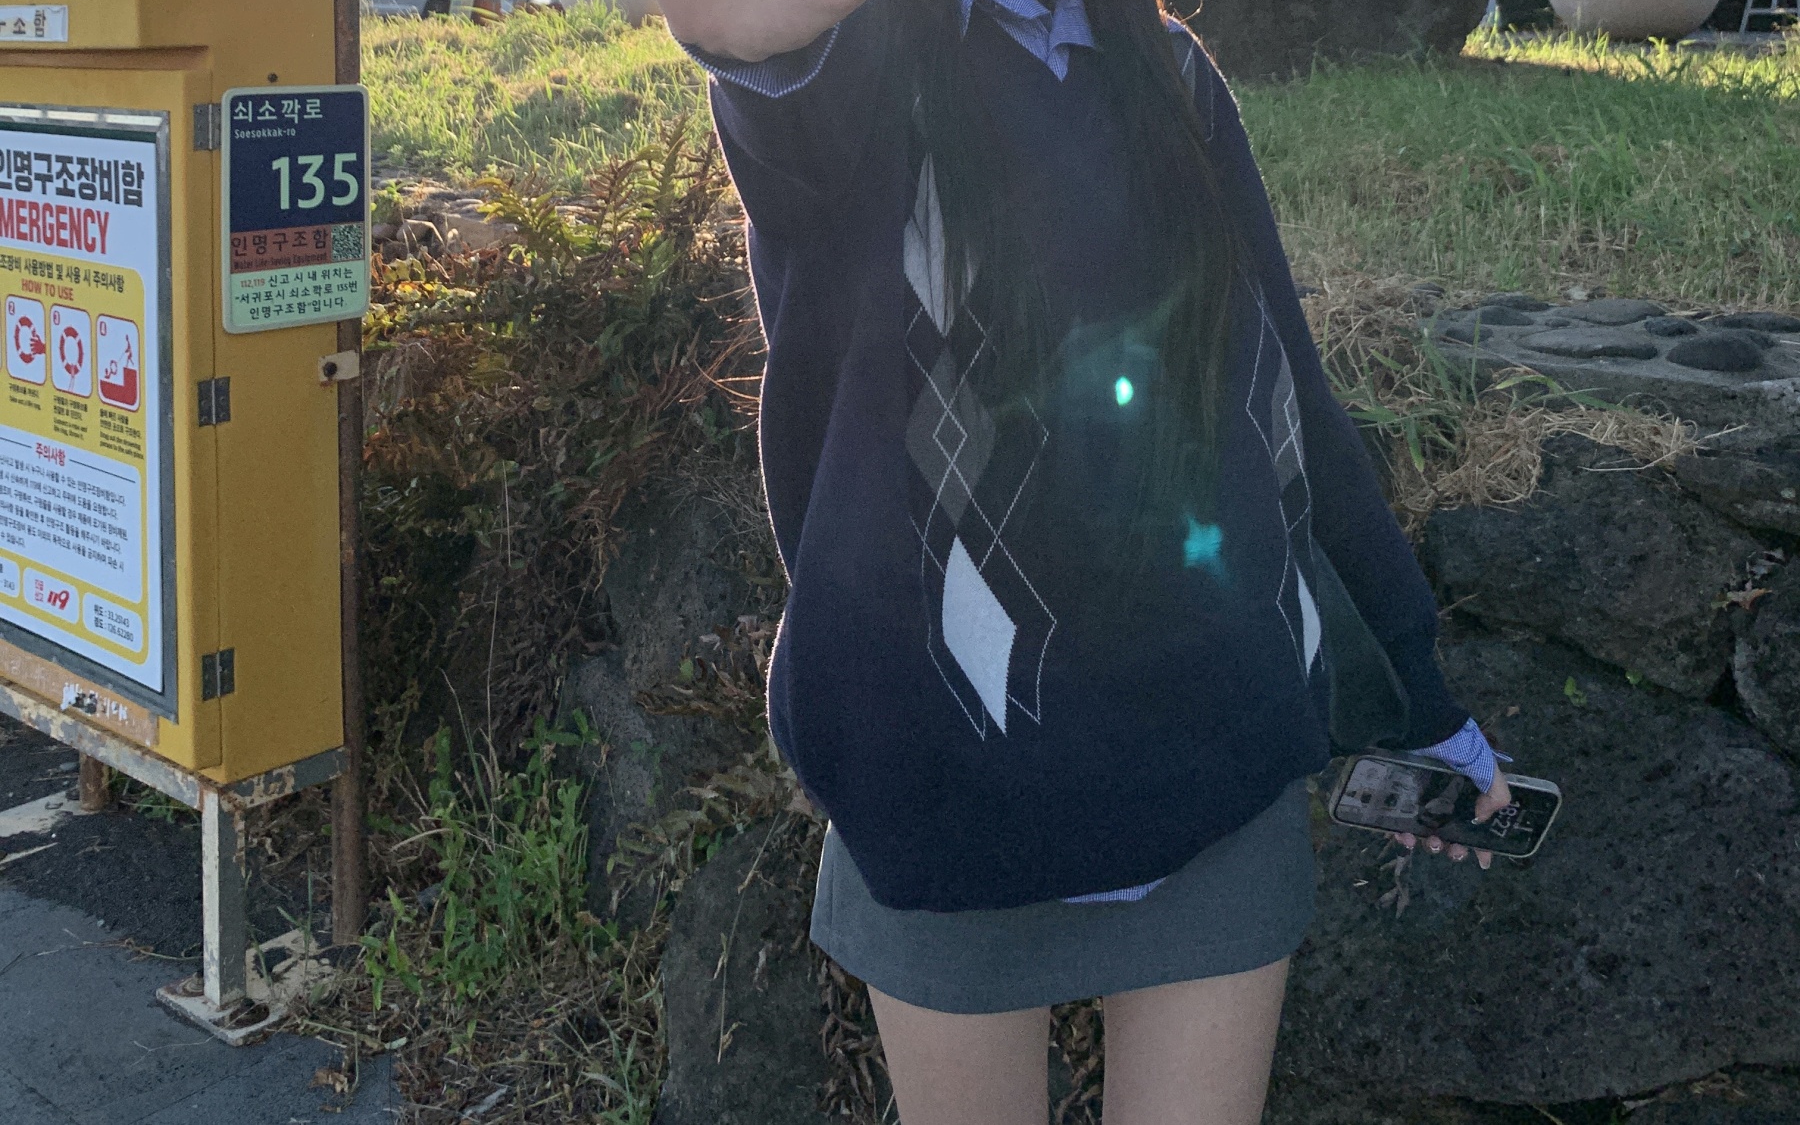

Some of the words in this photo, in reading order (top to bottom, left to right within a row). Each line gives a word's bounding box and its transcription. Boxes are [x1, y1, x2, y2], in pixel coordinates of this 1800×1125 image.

[233, 99, 323, 124] 쇠소깍로
[234, 128, 297, 139] Soesokkak-ro
[272, 152, 359, 210] 135
[231, 229, 329, 257] 인명구조함
[24, 258, 54, 279] 사용방법
[66, 266, 81, 284] 사용
[83, 269, 91, 287] 시
[93, 270, 125, 293] 주의사항
[268, 274, 289, 287] 신고
[294, 272, 304, 283] 시
[308, 270, 317, 281] 내
[321, 267, 353, 280] 위치는
[21, 278, 42, 294] HOW
[44, 283, 55, 297] TO
[58, 286, 74, 301] USE
[35, 442, 65, 467] 주의사항
[47, 590, 70, 610] 119
